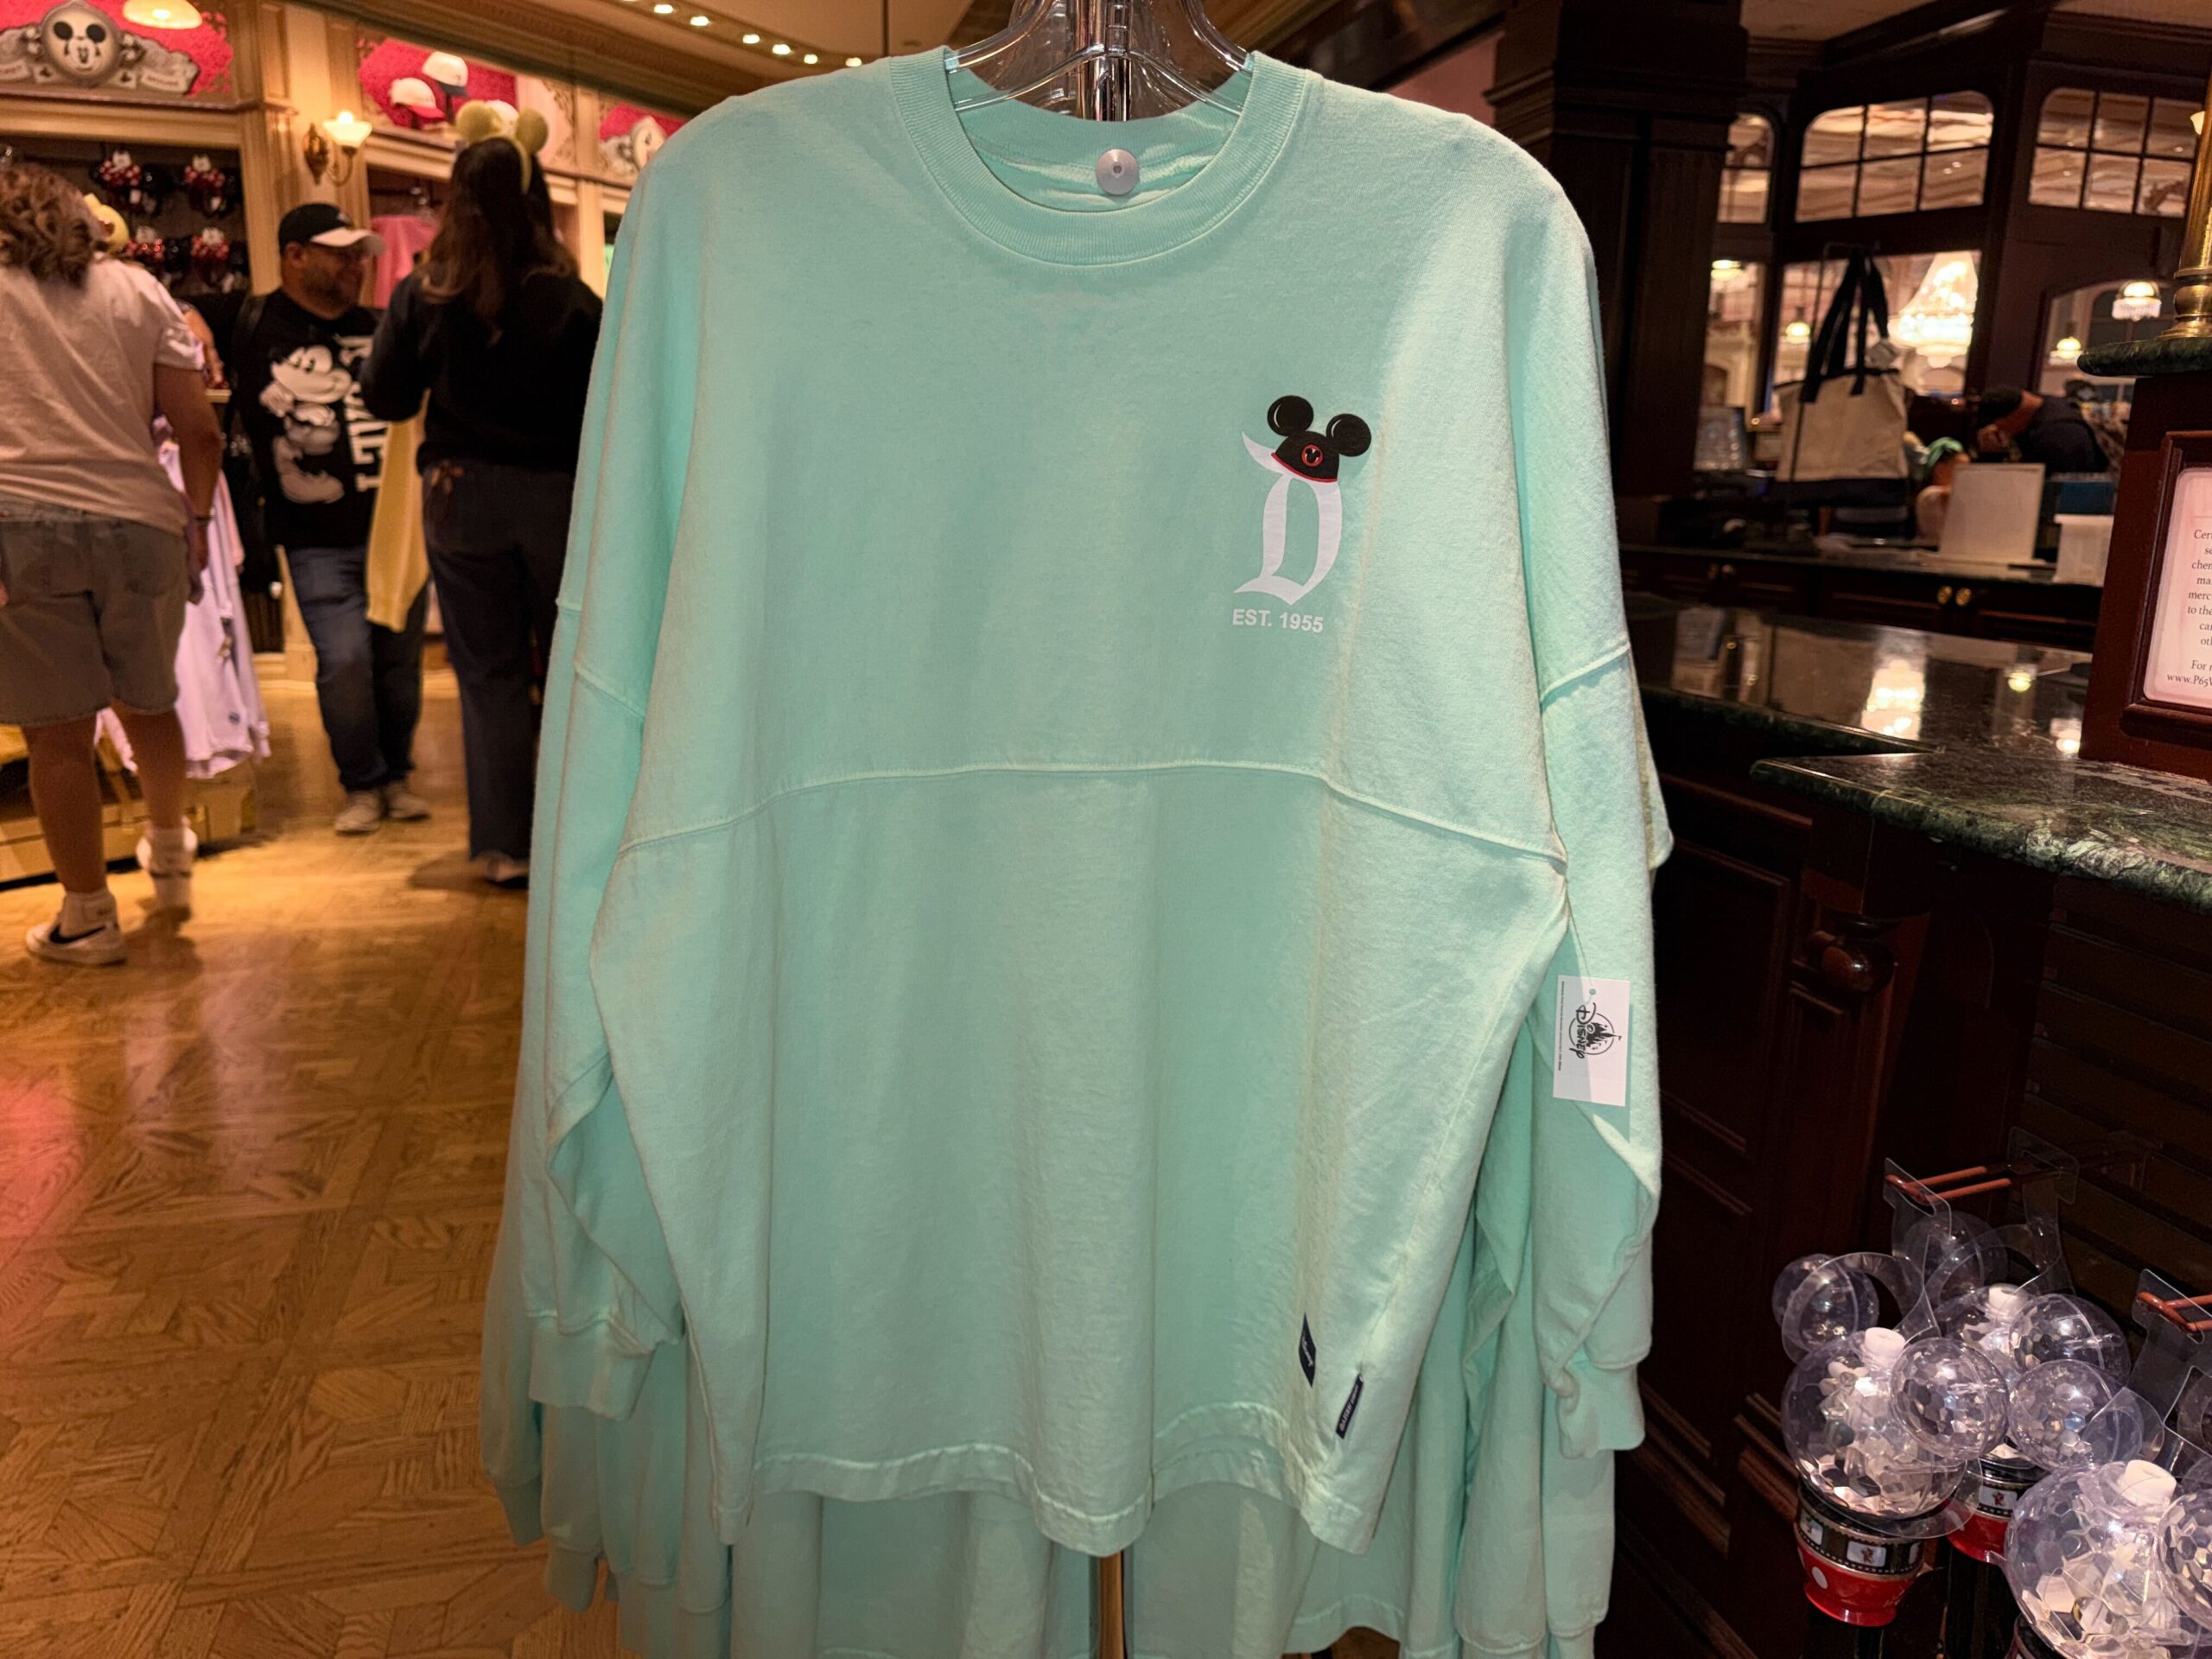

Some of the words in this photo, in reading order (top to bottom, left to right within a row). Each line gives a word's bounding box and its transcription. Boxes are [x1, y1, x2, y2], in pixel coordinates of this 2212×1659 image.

[1233, 431, 1343, 606] D
[2194, 529, 2212, 540] Cer
[2187, 606, 2197, 614] to
[1232, 608, 1272, 626] EST.
[1279, 612, 1324, 633] 1955
[2190, 659, 2207, 671] For
